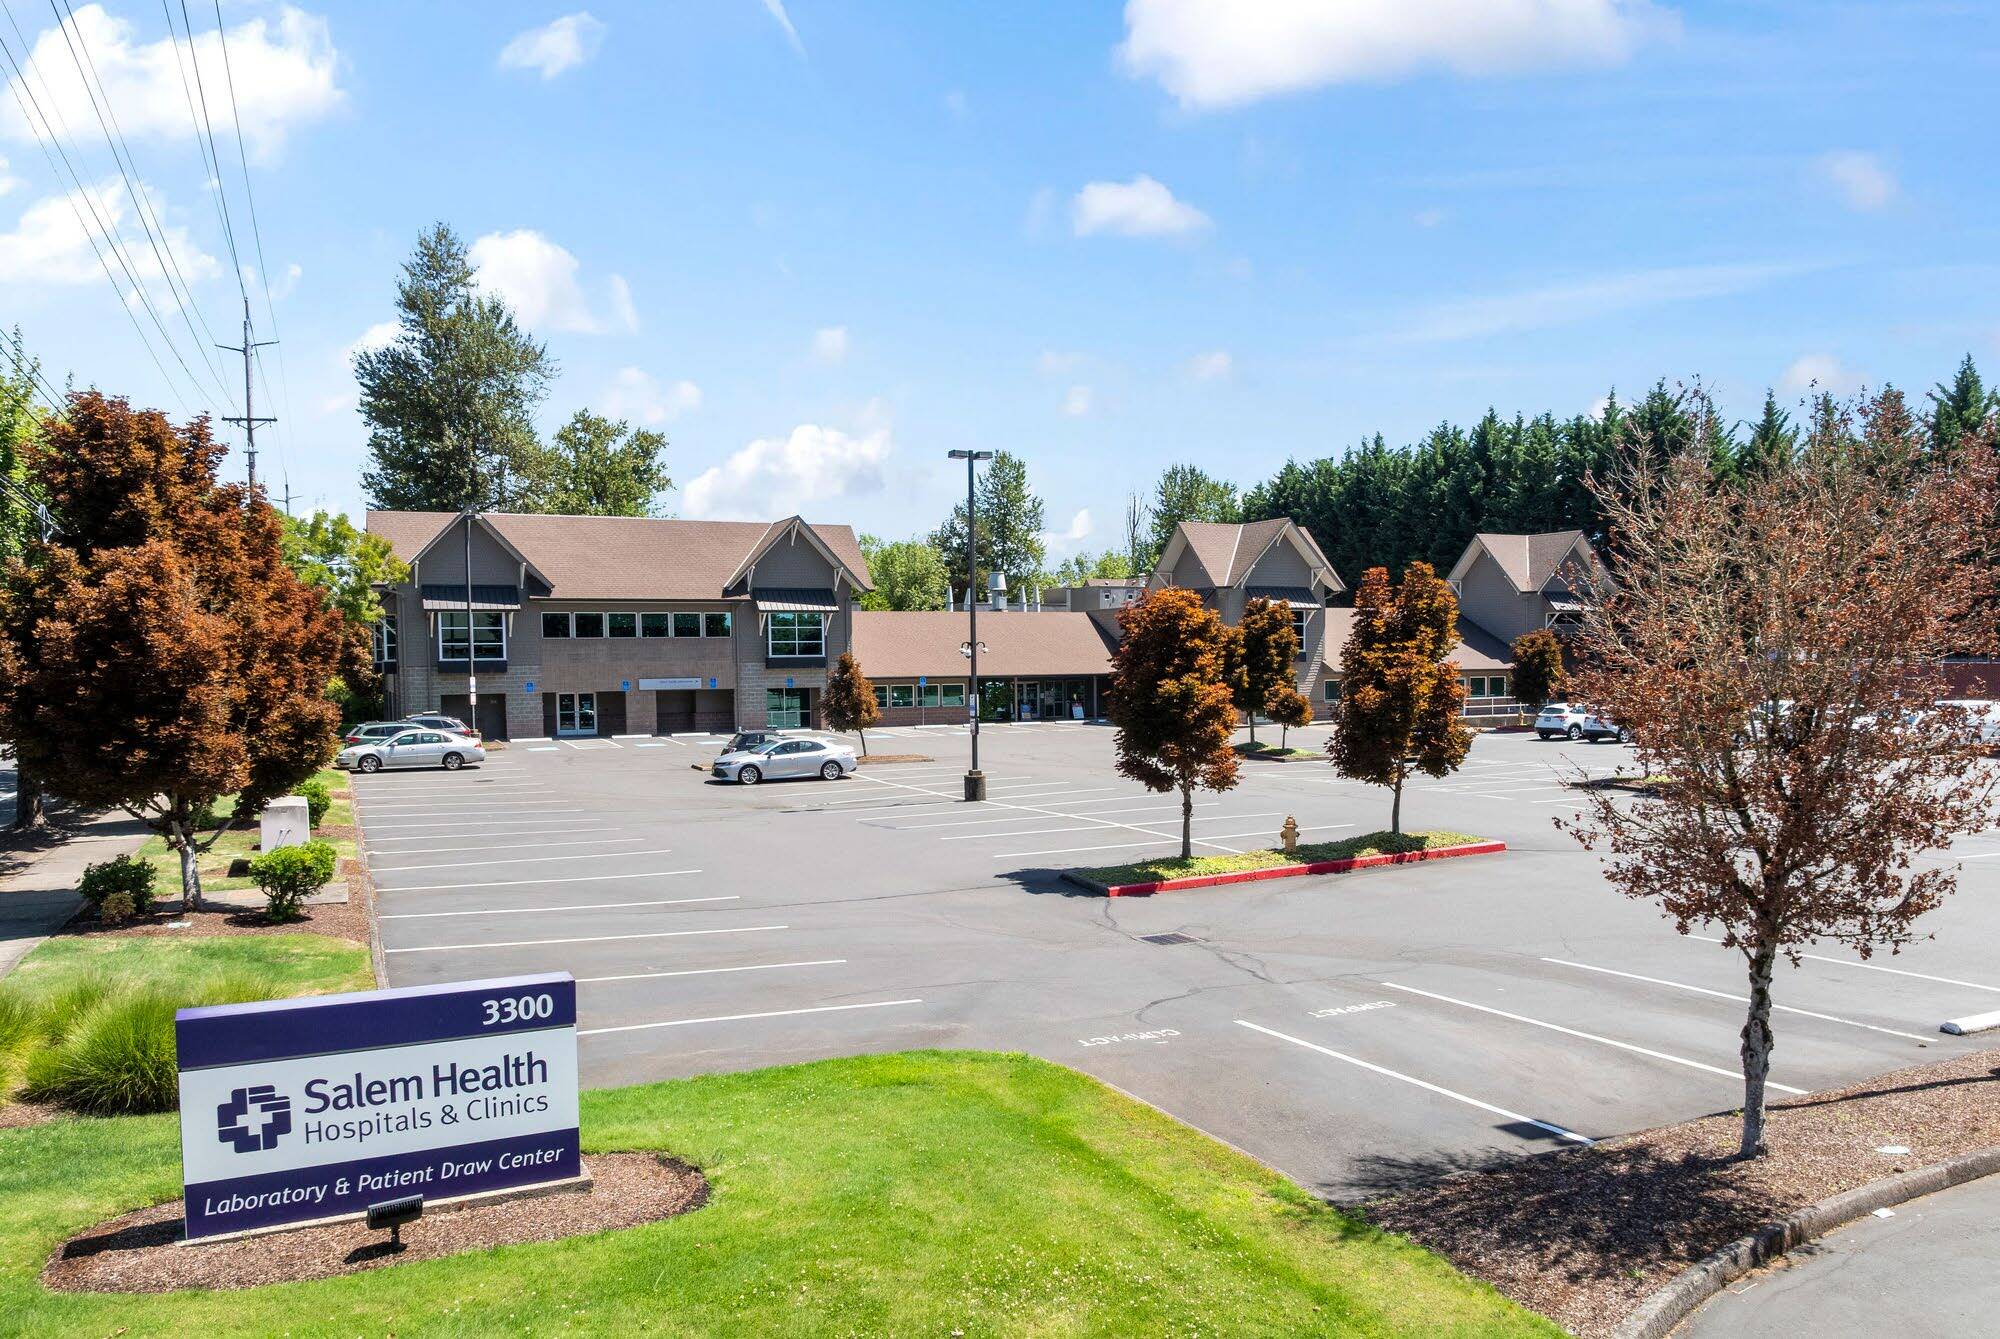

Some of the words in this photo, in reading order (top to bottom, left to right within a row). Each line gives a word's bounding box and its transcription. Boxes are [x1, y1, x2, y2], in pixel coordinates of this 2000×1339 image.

[482, 994, 554, 1025] 3300
[304, 1072, 423, 1114] Salem
[433, 1051, 548, 1098] Health
[305, 1107, 432, 1144] Hospitals
[440, 1104, 459, 1125] &
[466, 1094, 549, 1121] Clinics
[204, 1183, 327, 1216] Laboratory
[334, 1177, 350, 1196] &
[358, 1165, 434, 1193] Patient
[441, 1157, 492, 1180] Draw
[498, 1145, 565, 1170] Center
